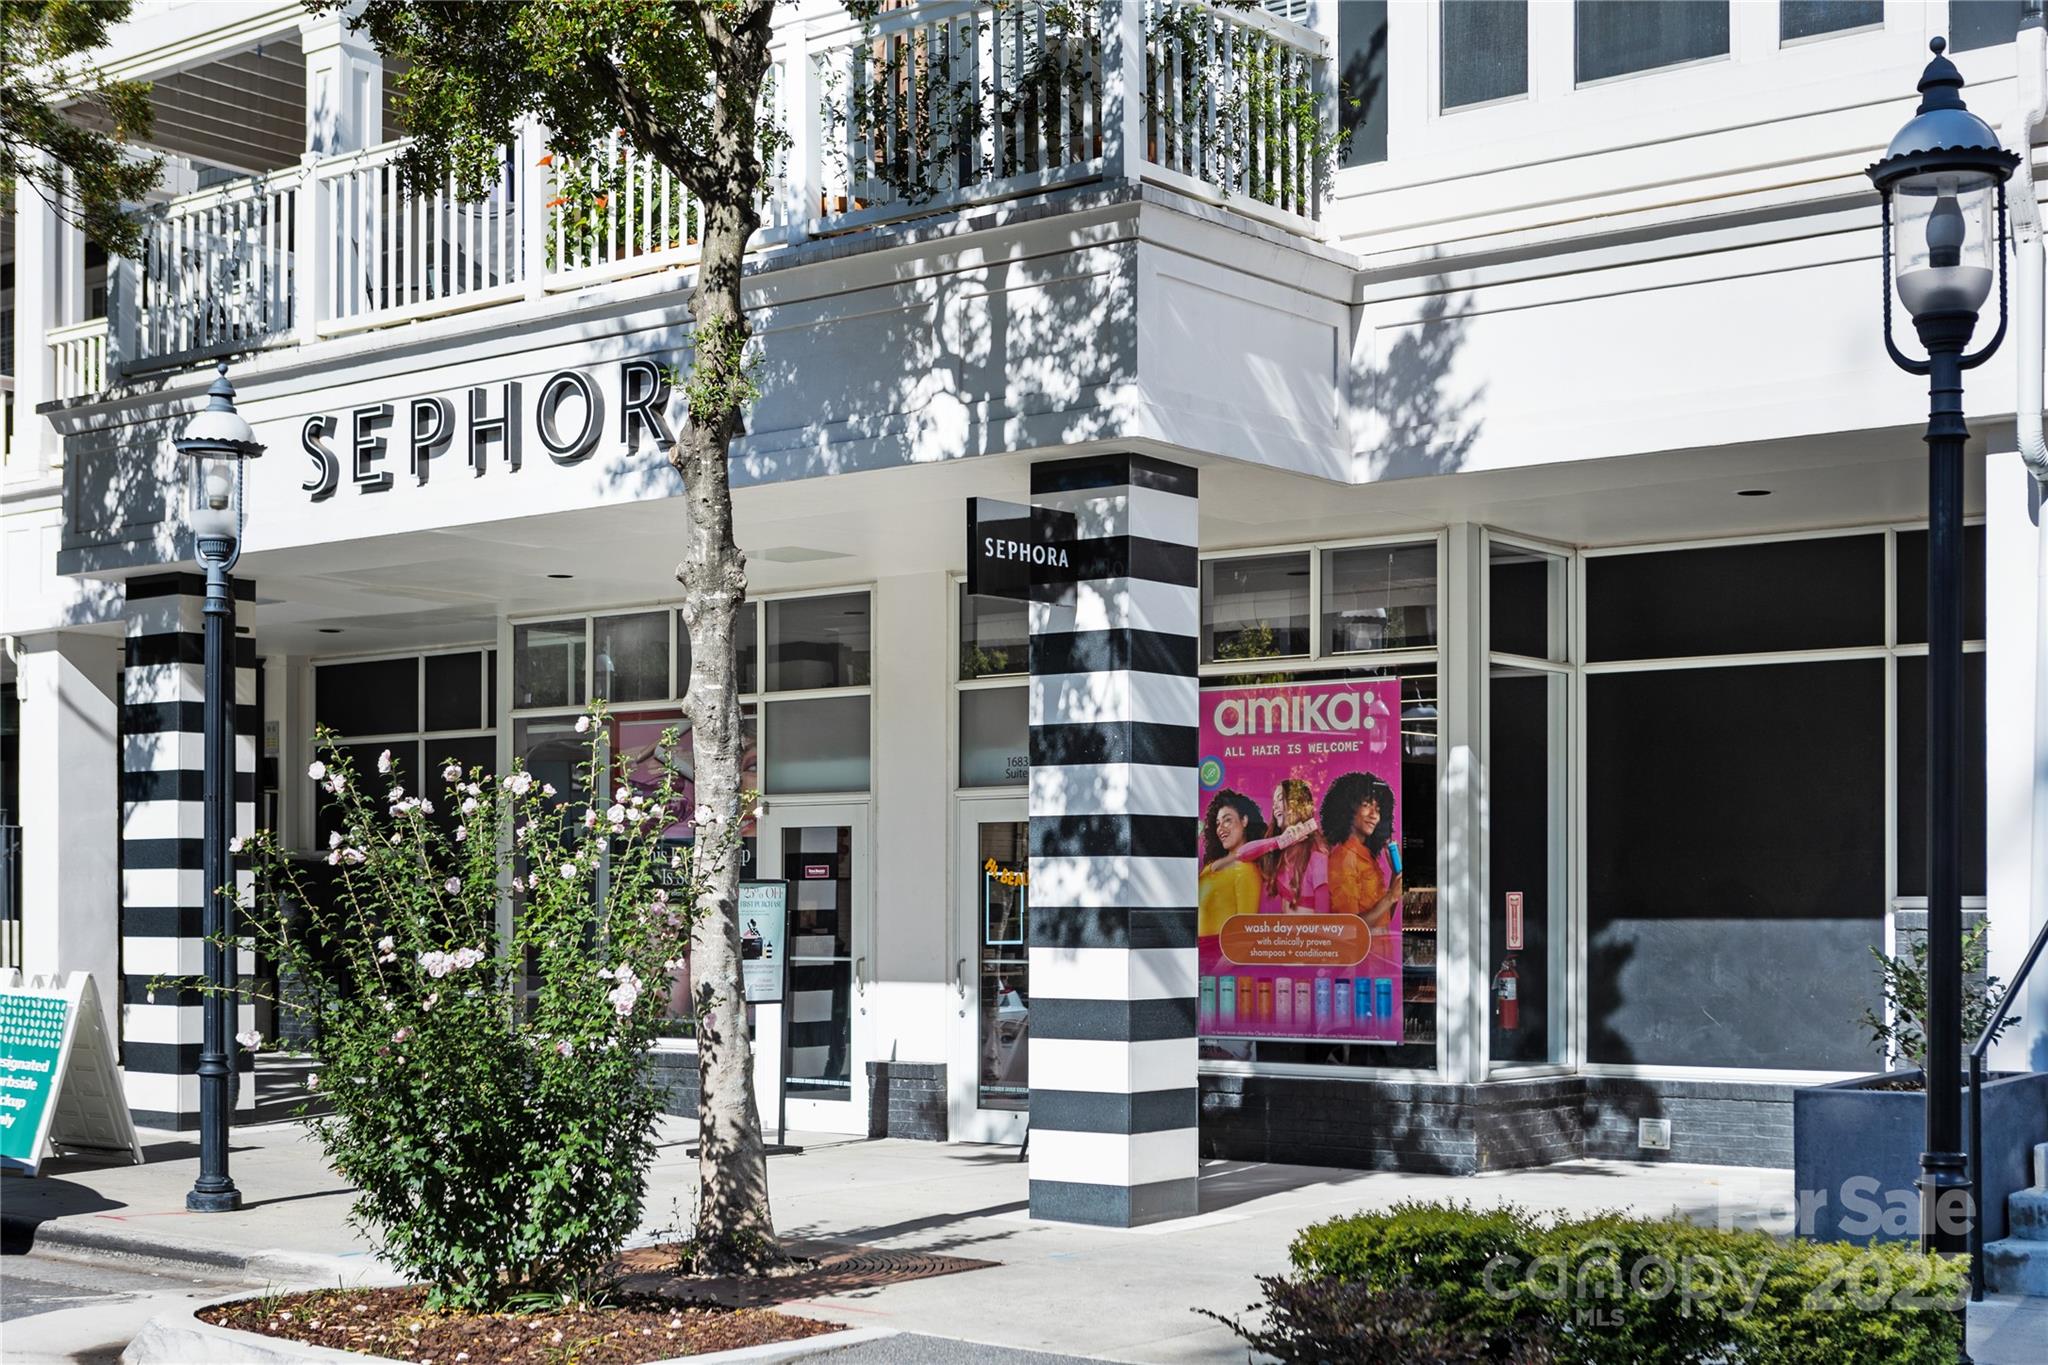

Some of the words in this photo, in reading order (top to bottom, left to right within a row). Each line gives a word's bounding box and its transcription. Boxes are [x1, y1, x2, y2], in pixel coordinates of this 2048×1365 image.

[302, 359, 745, 503] SEPHOR
[985, 537, 1069, 568] SEPHORA
[1224, 746, 1246, 757] ALL
[1251, 744, 1281, 756] HAIR
[1287, 743, 1302, 754] IS
[1007, 756, 1029, 768] 1683
[1005, 768, 1029, 779] Suite
[1244, 920, 1270, 934] wash
[1272, 920, 1293, 937] day
[1295, 924, 1320, 937] your
[1321, 924, 1345, 937] way
[1256, 936, 1272, 946] with
[1273, 936, 1304, 948] clinically
[1306, 939, 1332, 948] proven
[1249, 947, 1286, 958] shampoos
[1294, 948, 1339, 958] conditioners
